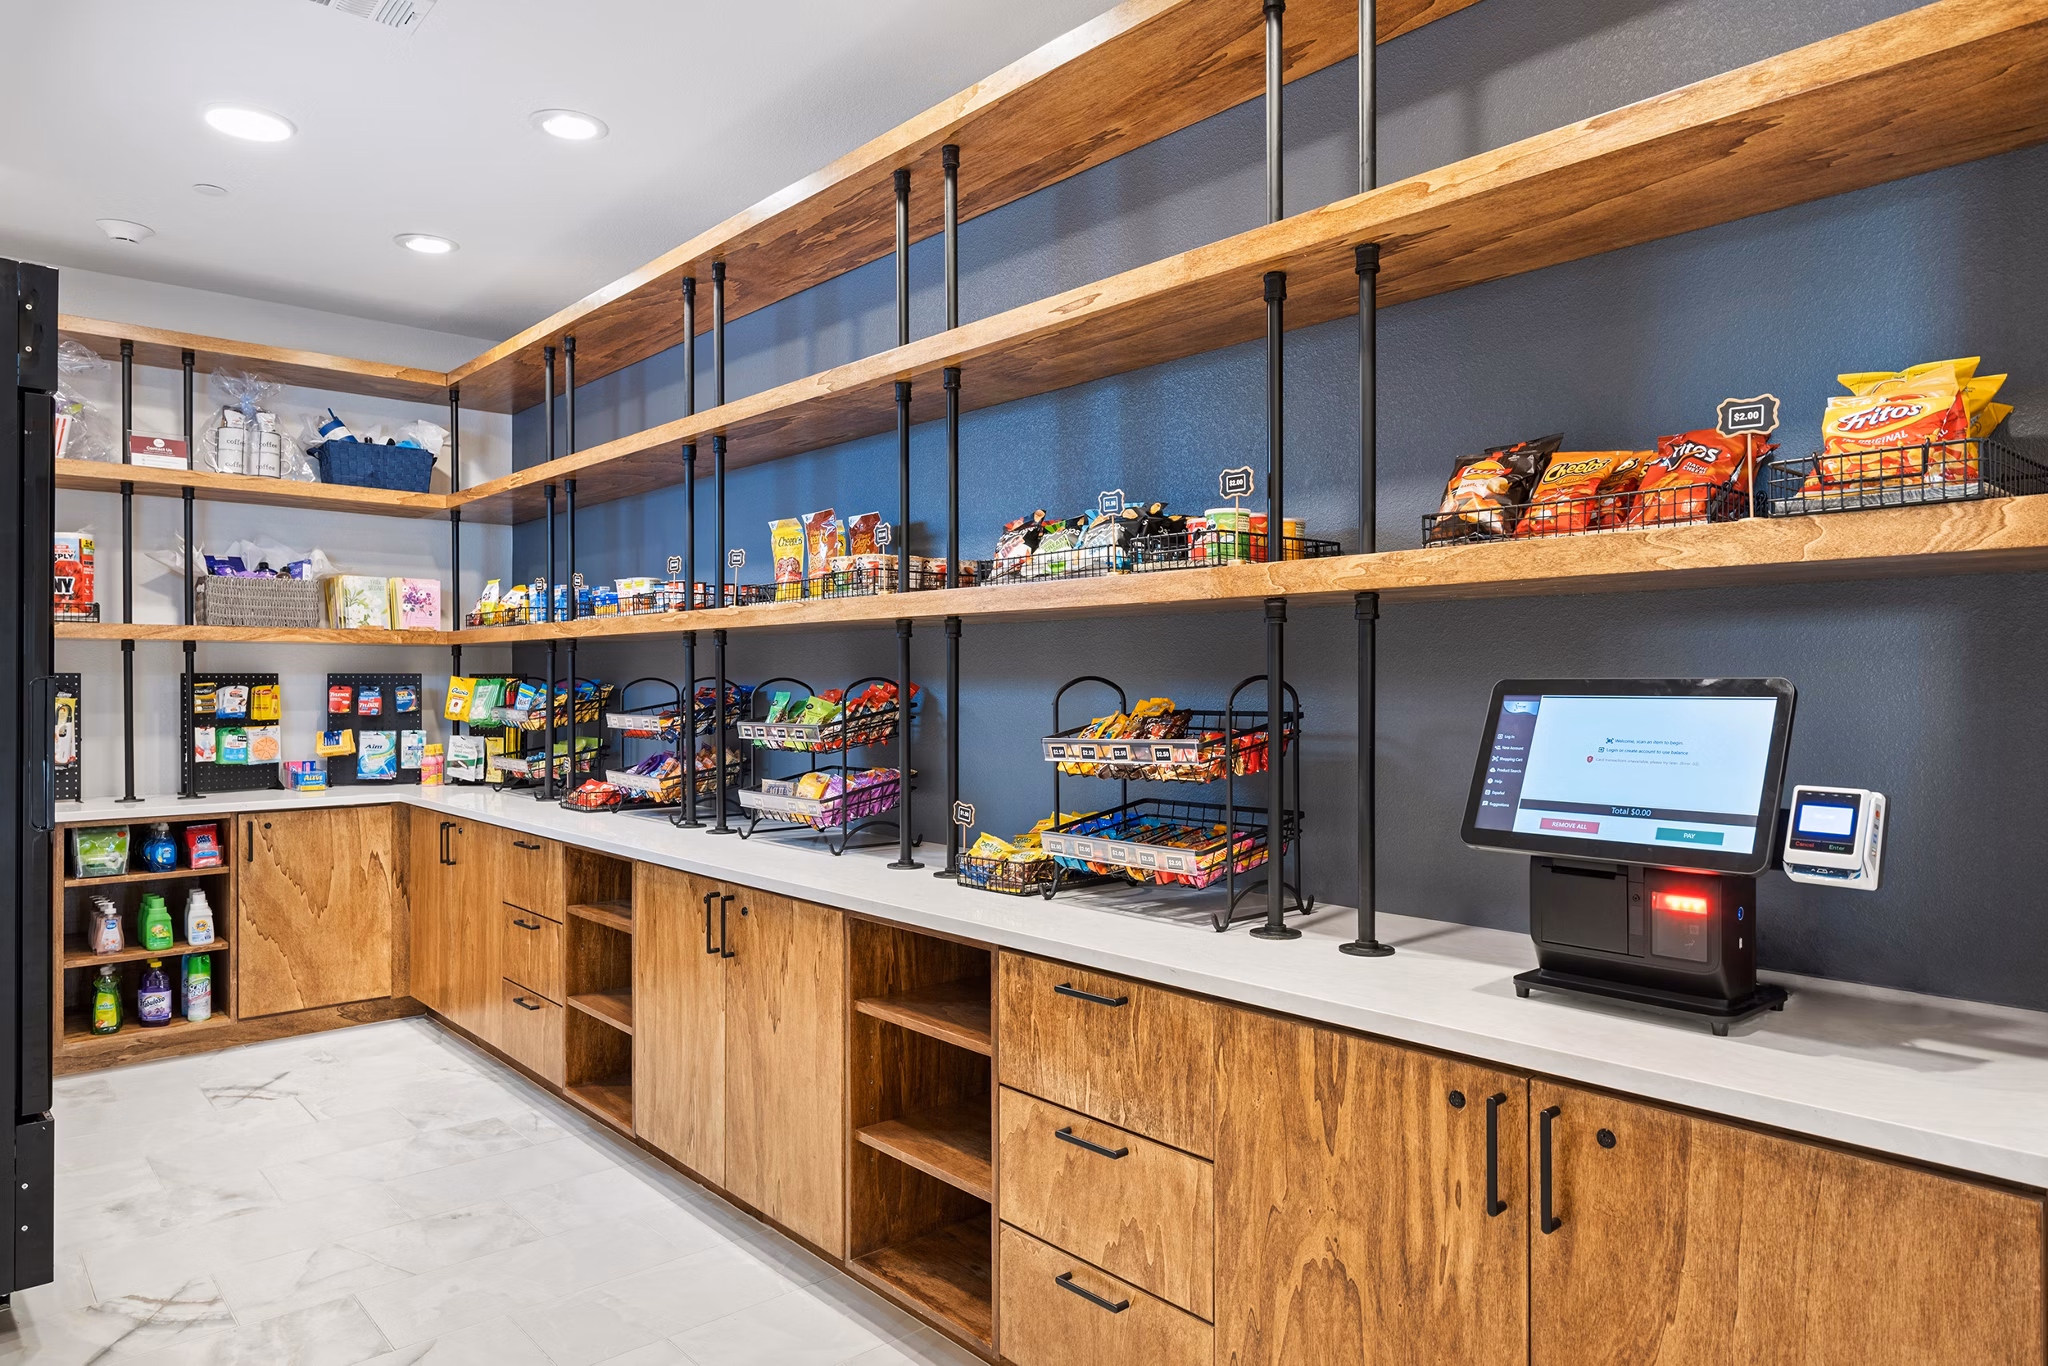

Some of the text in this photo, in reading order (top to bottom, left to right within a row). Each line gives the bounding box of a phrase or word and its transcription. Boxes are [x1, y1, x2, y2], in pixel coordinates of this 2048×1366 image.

[1733, 411, 1760, 422] $2.00
[1837, 404, 1923, 431] Fritos
[1857, 430, 1909, 444] ORIGINAL
[259, 441, 278, 449] coffee
[1672, 443, 1719, 462] ritos
[1543, 458, 1612, 482] Cheetos
[1228, 478, 1244, 487] $2.00
[1611, 807, 1652, 817] Total $0.00
[1551, 821, 1576, 829] REMOVE
[1168, 859, 1182, 867] $2.50
